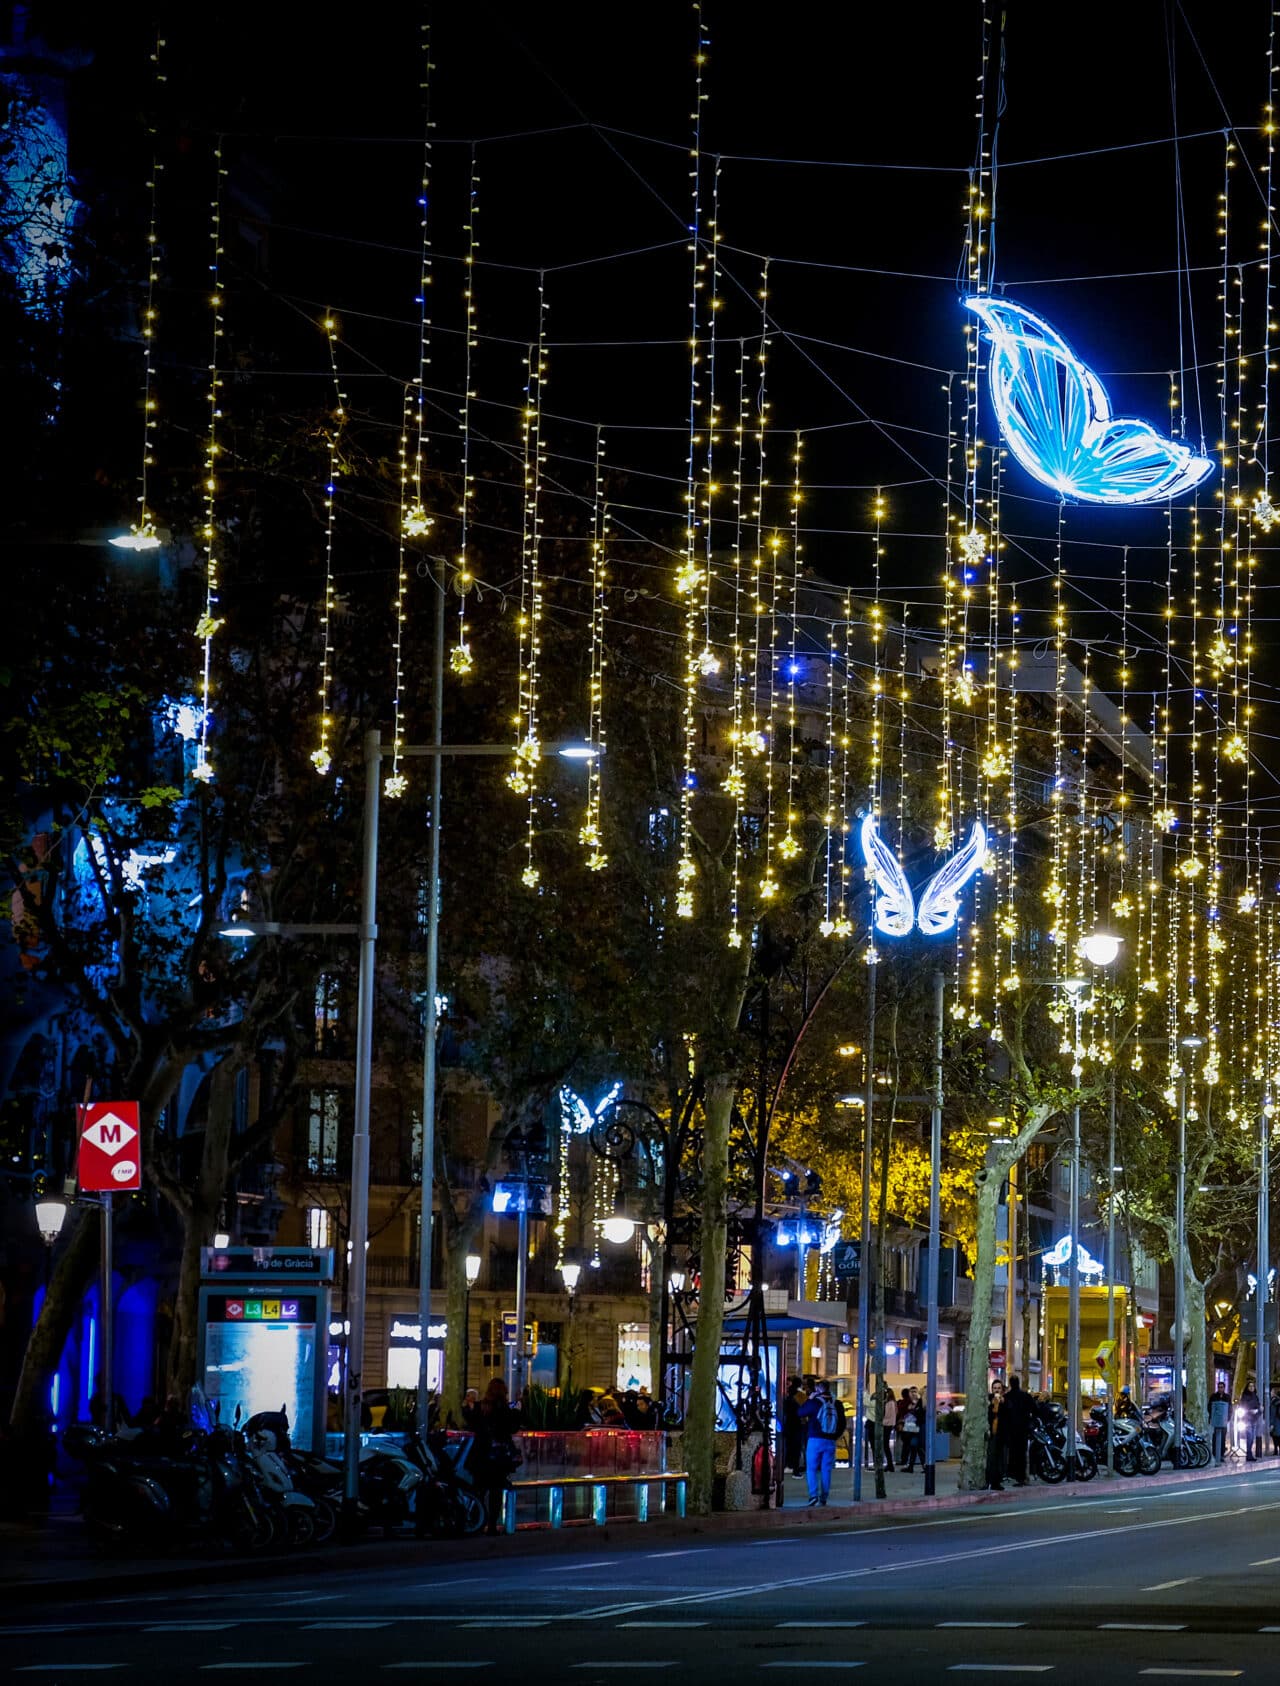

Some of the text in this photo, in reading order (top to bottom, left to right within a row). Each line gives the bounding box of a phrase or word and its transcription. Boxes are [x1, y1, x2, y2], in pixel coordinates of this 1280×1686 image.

[100, 1124, 121, 1144] M
[271, 1259, 283, 1268] de
[246, 1304, 261, 1315] L3
[264, 1304, 278, 1315] L4
[281, 1304, 297, 1316] L2
